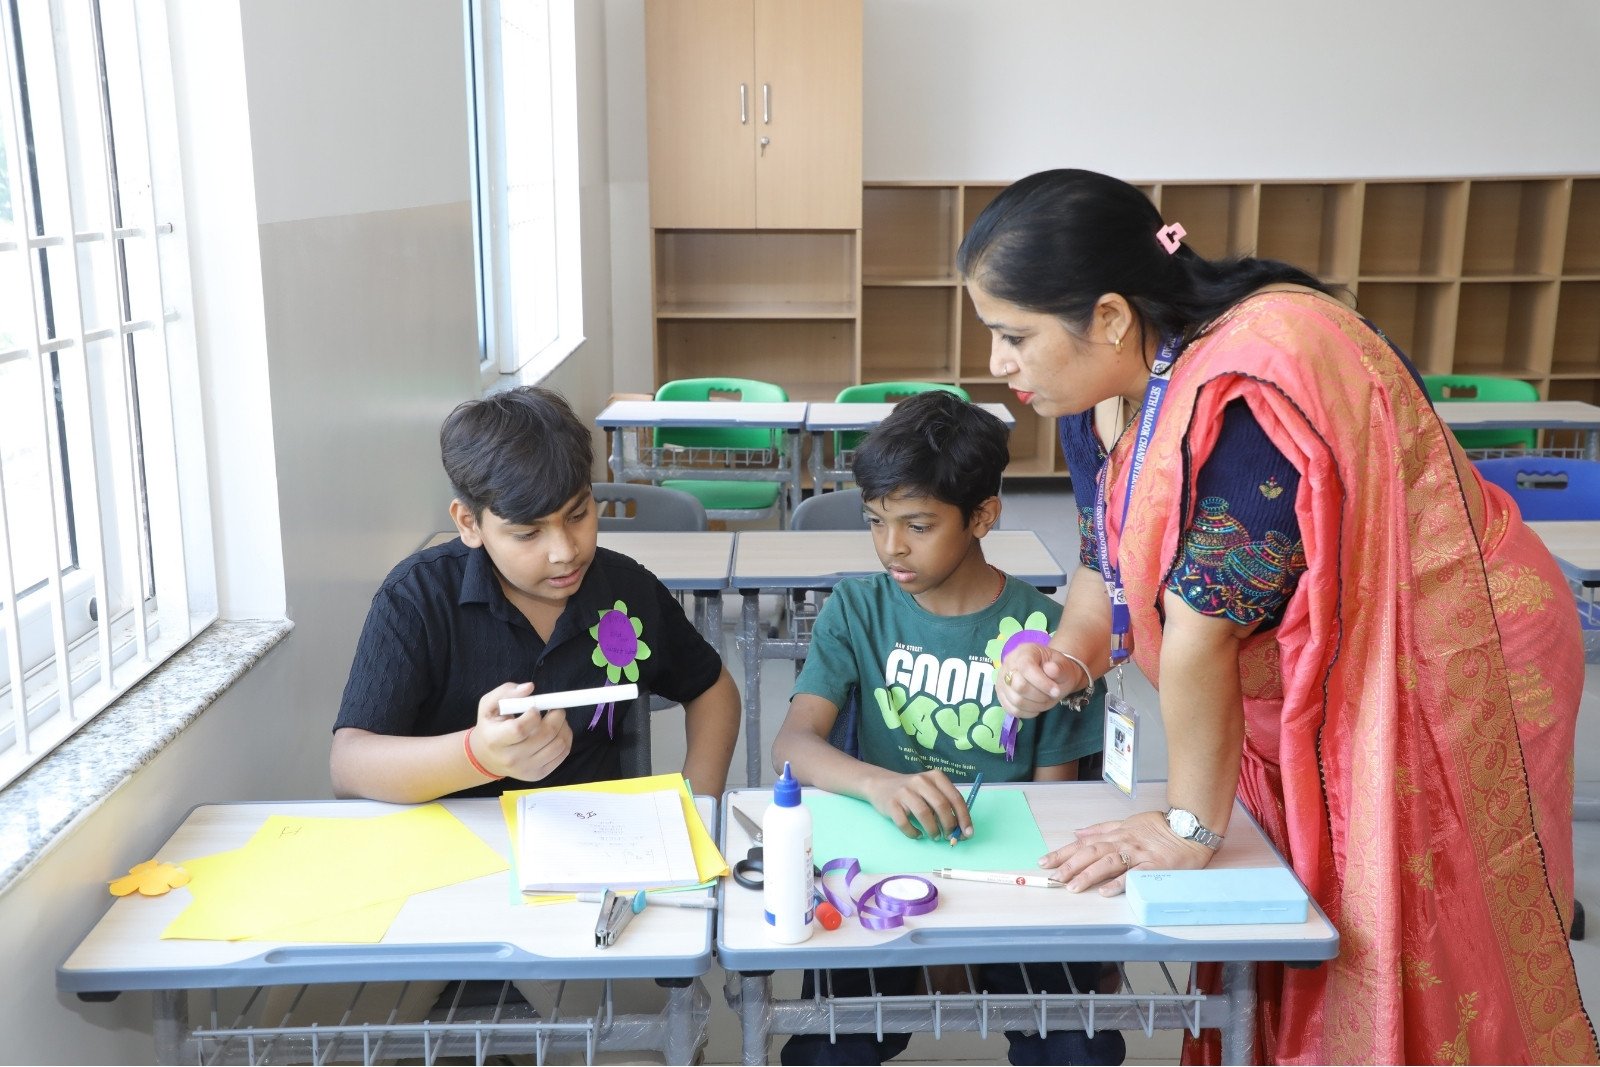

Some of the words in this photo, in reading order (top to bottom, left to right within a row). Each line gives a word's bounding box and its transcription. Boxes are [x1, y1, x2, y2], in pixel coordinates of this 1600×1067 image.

[1147, 386, 1162, 407] SETH
[1140, 406, 1156, 438] MALOOK
[1136, 436, 1148, 462] CHAND
[1096, 506, 1104, 530] CHAND
[1098, 530, 1108, 561] MALOOK
[1102, 561, 1112, 579] SETH
[895, 642, 906, 650] RAW
[906, 645, 923, 653] STREET
[885, 648, 996, 707] GOOD
